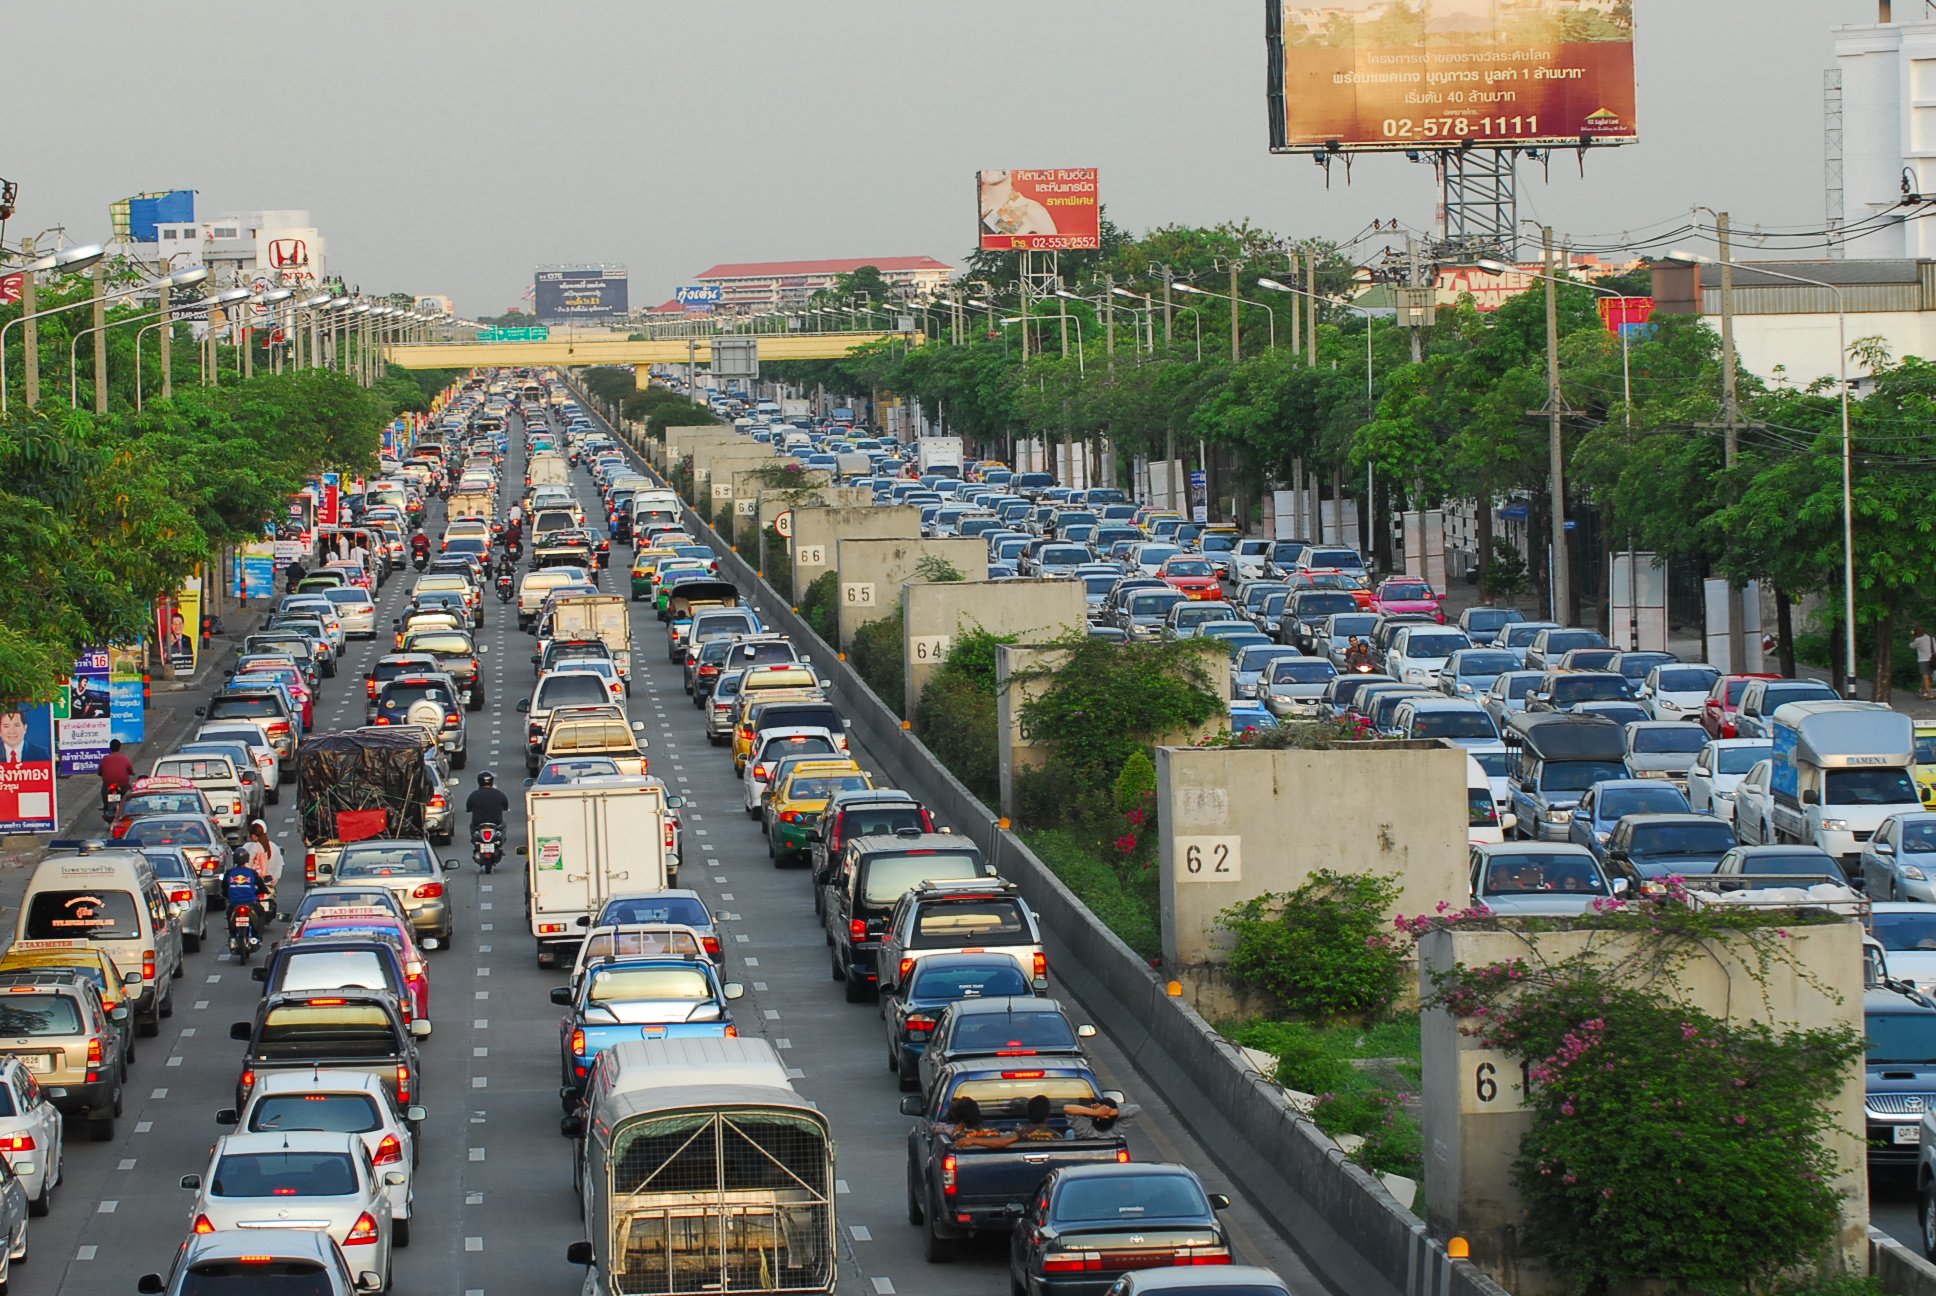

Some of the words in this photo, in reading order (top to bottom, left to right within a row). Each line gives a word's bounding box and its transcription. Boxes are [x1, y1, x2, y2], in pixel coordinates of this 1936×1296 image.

[1426, 70, 1480, 85] บุญถาวร
[1485, 67, 1517, 84] มูลค่า
[1522, 70, 1529, 79] 1
[1405, 89, 1442, 104] เริ่มต้น
[1447, 91, 1464, 103] 40
[1468, 90, 1516, 102] ล้านบาท
[1383, 115, 1538, 137] 02-578-1111
[1047, 196, 1094, 206] ราคาพิเศษ
[1032, 237, 1096, 248] 02-553-2552
[715, 486, 729, 496] 69
[738, 502, 754, 513] 68
[801, 549, 820, 563] 66
[847, 586, 870, 602] 65
[917, 641, 942, 659] 64
[94, 655, 107, 667] 16
[1855, 757, 1888, 765] AMENA
[1186, 843, 1230, 874] 62
[329, 907, 374, 915] TAXI-METER
[25, 940, 73, 949] TAXI-METER
